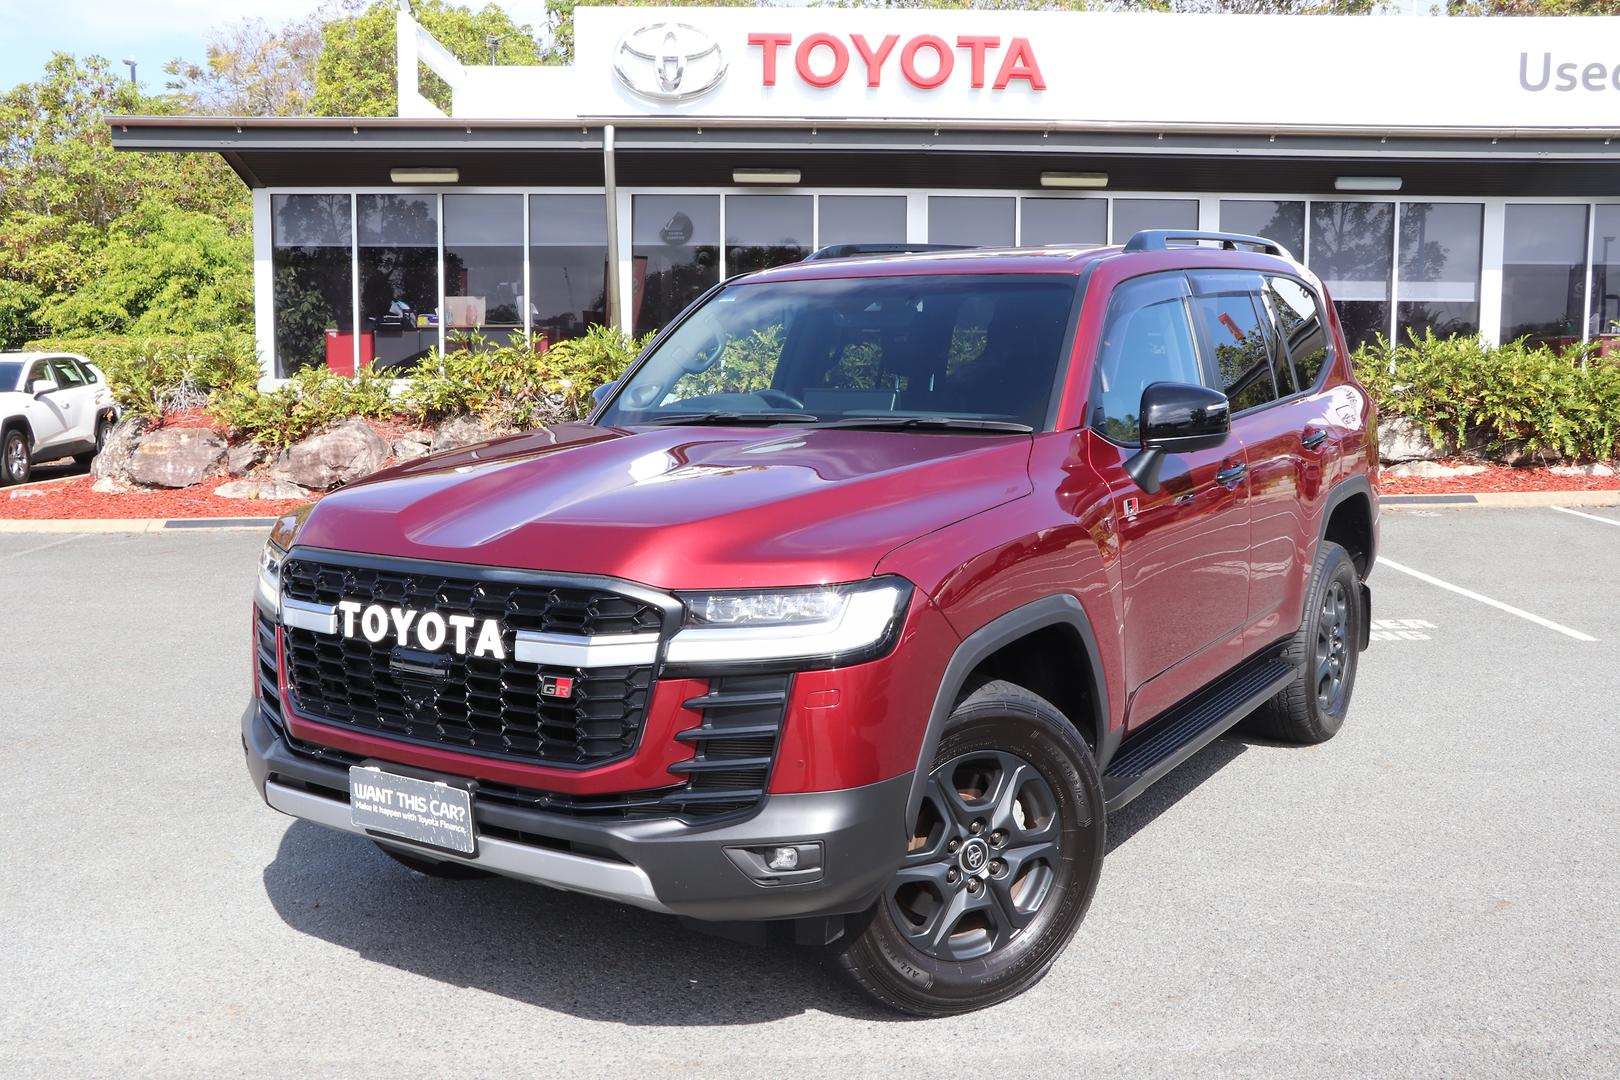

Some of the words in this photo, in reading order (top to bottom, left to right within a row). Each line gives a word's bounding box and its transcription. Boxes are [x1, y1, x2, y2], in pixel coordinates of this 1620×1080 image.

[748, 32, 1046, 91] TOYOTA
[338, 600, 505, 660] TOYOTA
[543, 684, 570, 697] GR
[353, 782, 394, 805] WANT
[396, 791, 428, 813] THIS
[429, 799, 466, 823] CAR?
[355, 801, 373, 812] Make
[379, 805, 402, 818] happen
[402, 812, 417, 822] with
[417, 814, 439, 827] Toyota
